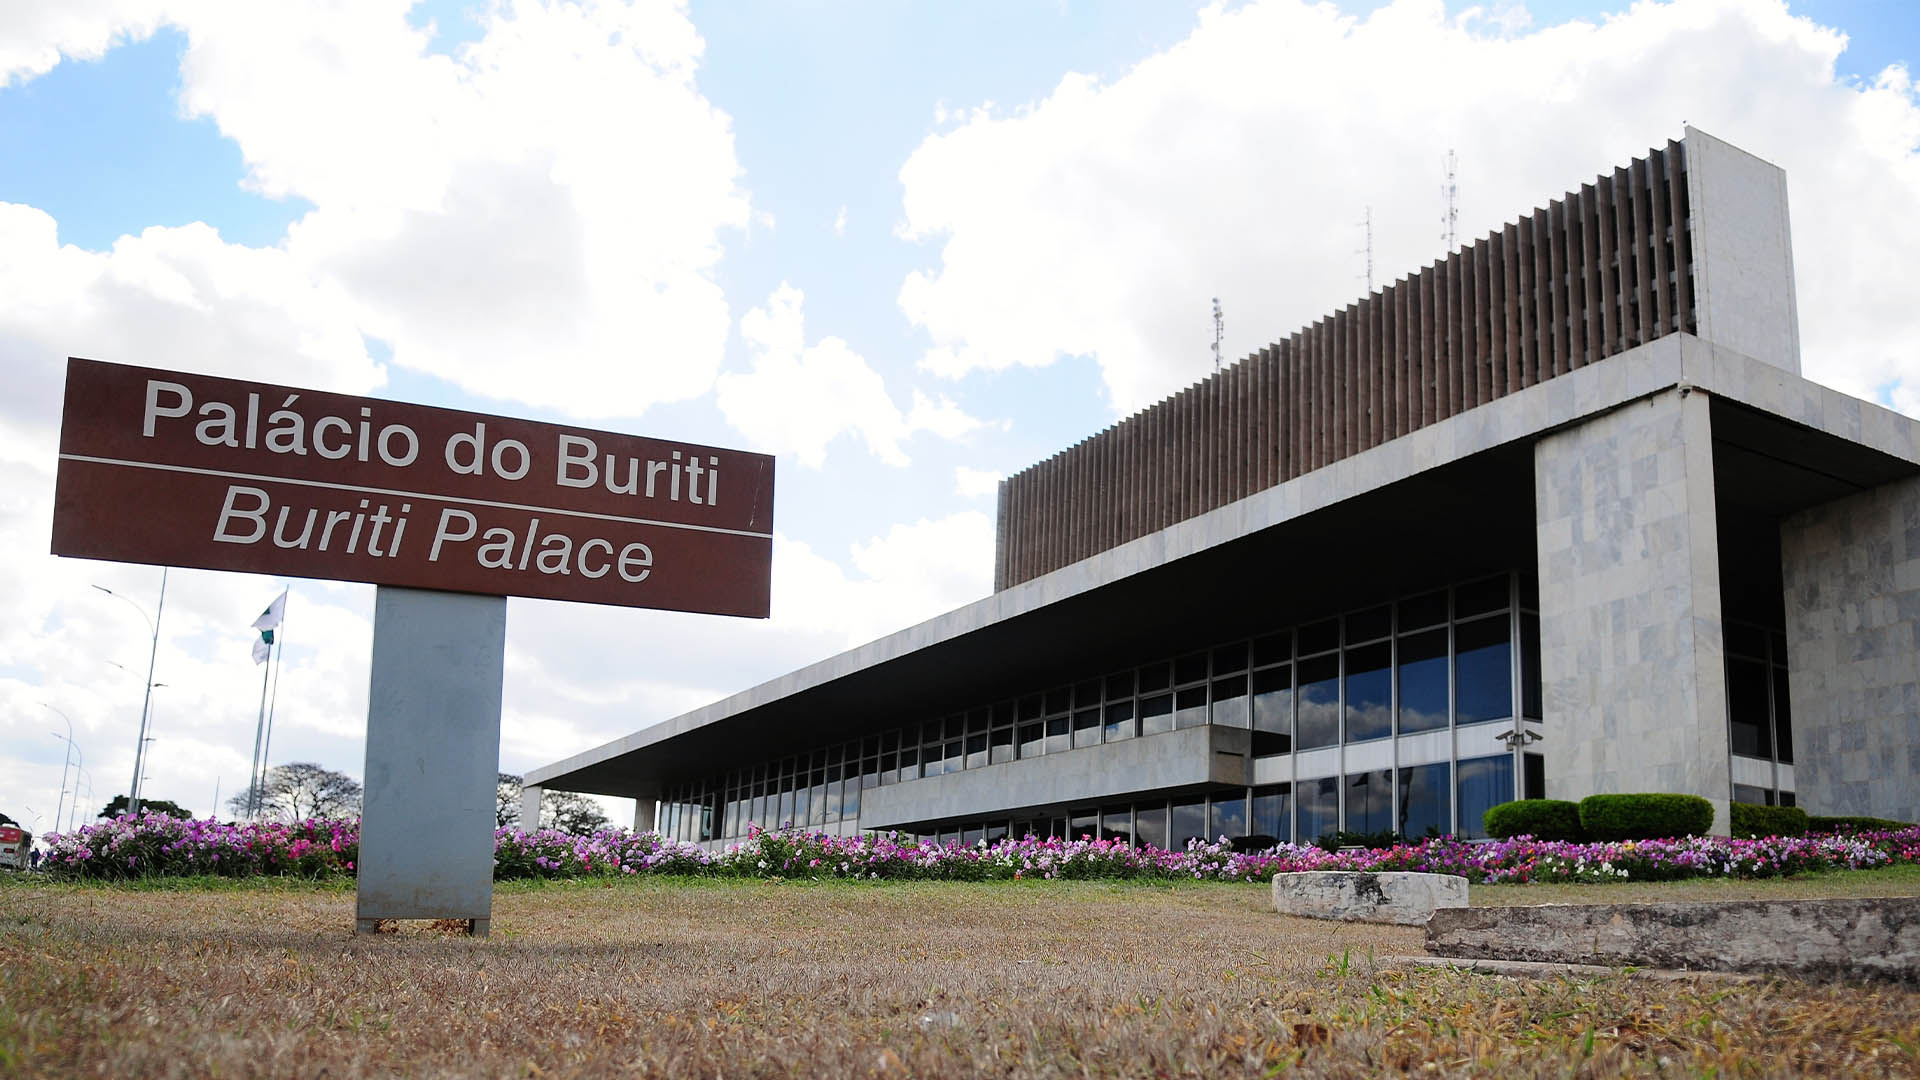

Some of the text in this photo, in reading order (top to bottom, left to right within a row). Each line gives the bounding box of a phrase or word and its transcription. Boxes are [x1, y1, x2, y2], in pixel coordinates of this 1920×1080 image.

[143, 380, 719, 506] Palácio do Buriti
[213, 485, 653, 583] Buriti Palace
